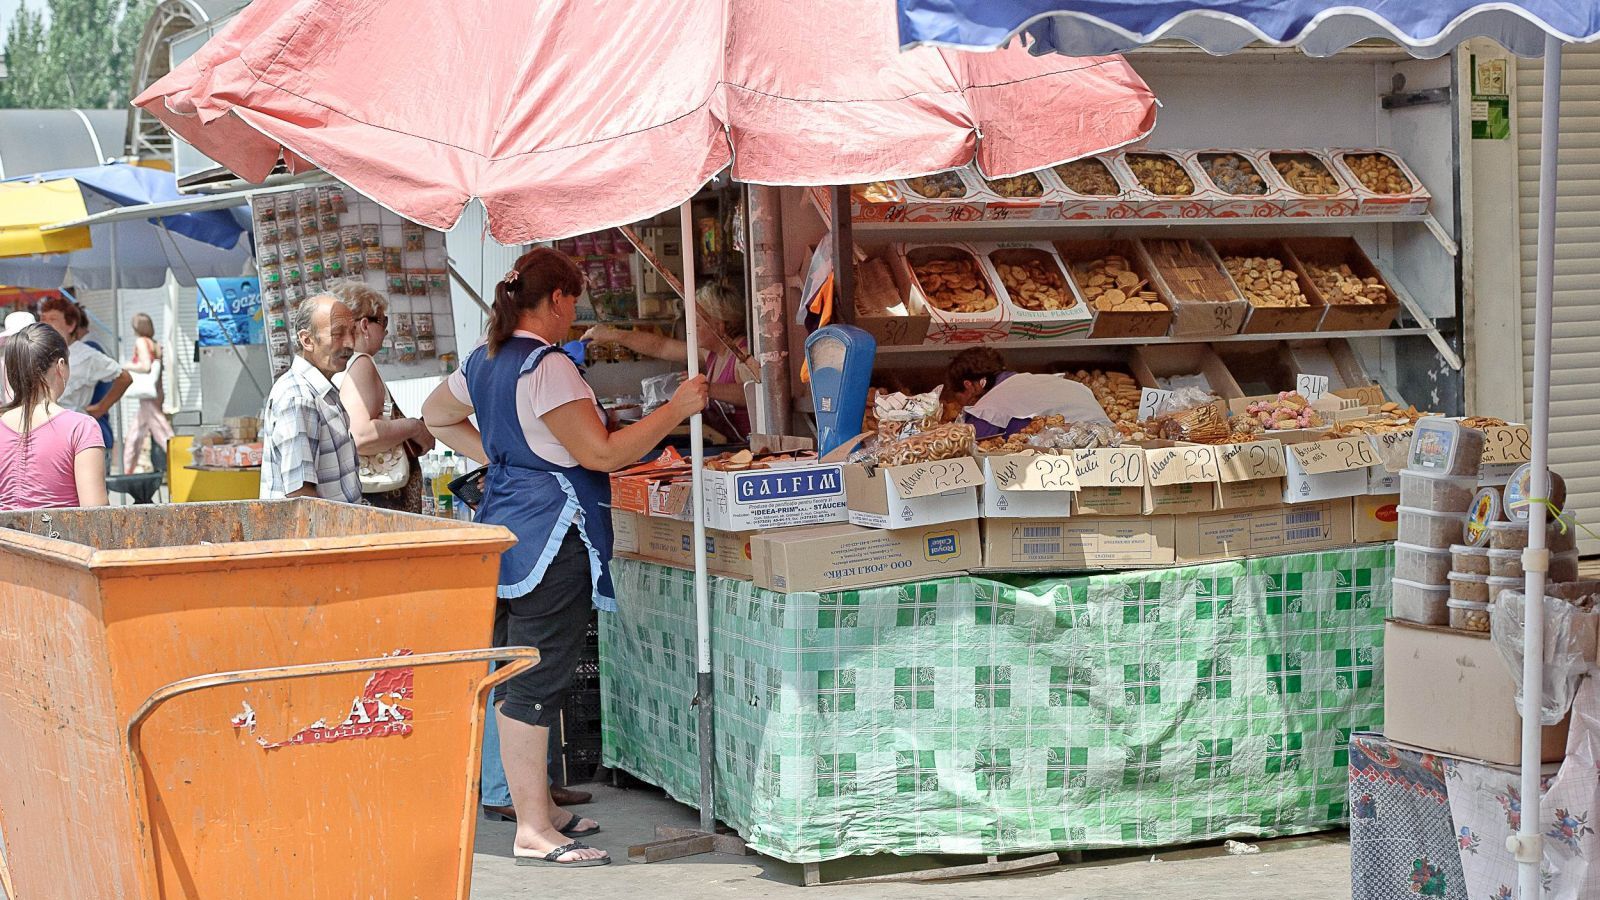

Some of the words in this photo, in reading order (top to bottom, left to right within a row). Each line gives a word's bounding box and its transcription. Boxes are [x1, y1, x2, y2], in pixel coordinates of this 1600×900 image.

[1299, 375, 1321, 400] 34
[1337, 440, 1373, 468] 26
[1497, 428, 1532, 461] 28
[1036, 459, 1074, 489] 22
[1110, 452, 1141, 484] 20
[1184, 448, 1215, 479] 22
[1250, 445, 1280, 476] 20
[742, 473, 837, 497] GALFIM
[929, 462, 971, 490] 22
[931, 538, 953, 547] Cake
[931, 544, 954, 555] Royal
[890, 560, 913, 570] ООО
[314, 726, 374, 740] QUALITY
[383, 724, 408, 733] TEA
